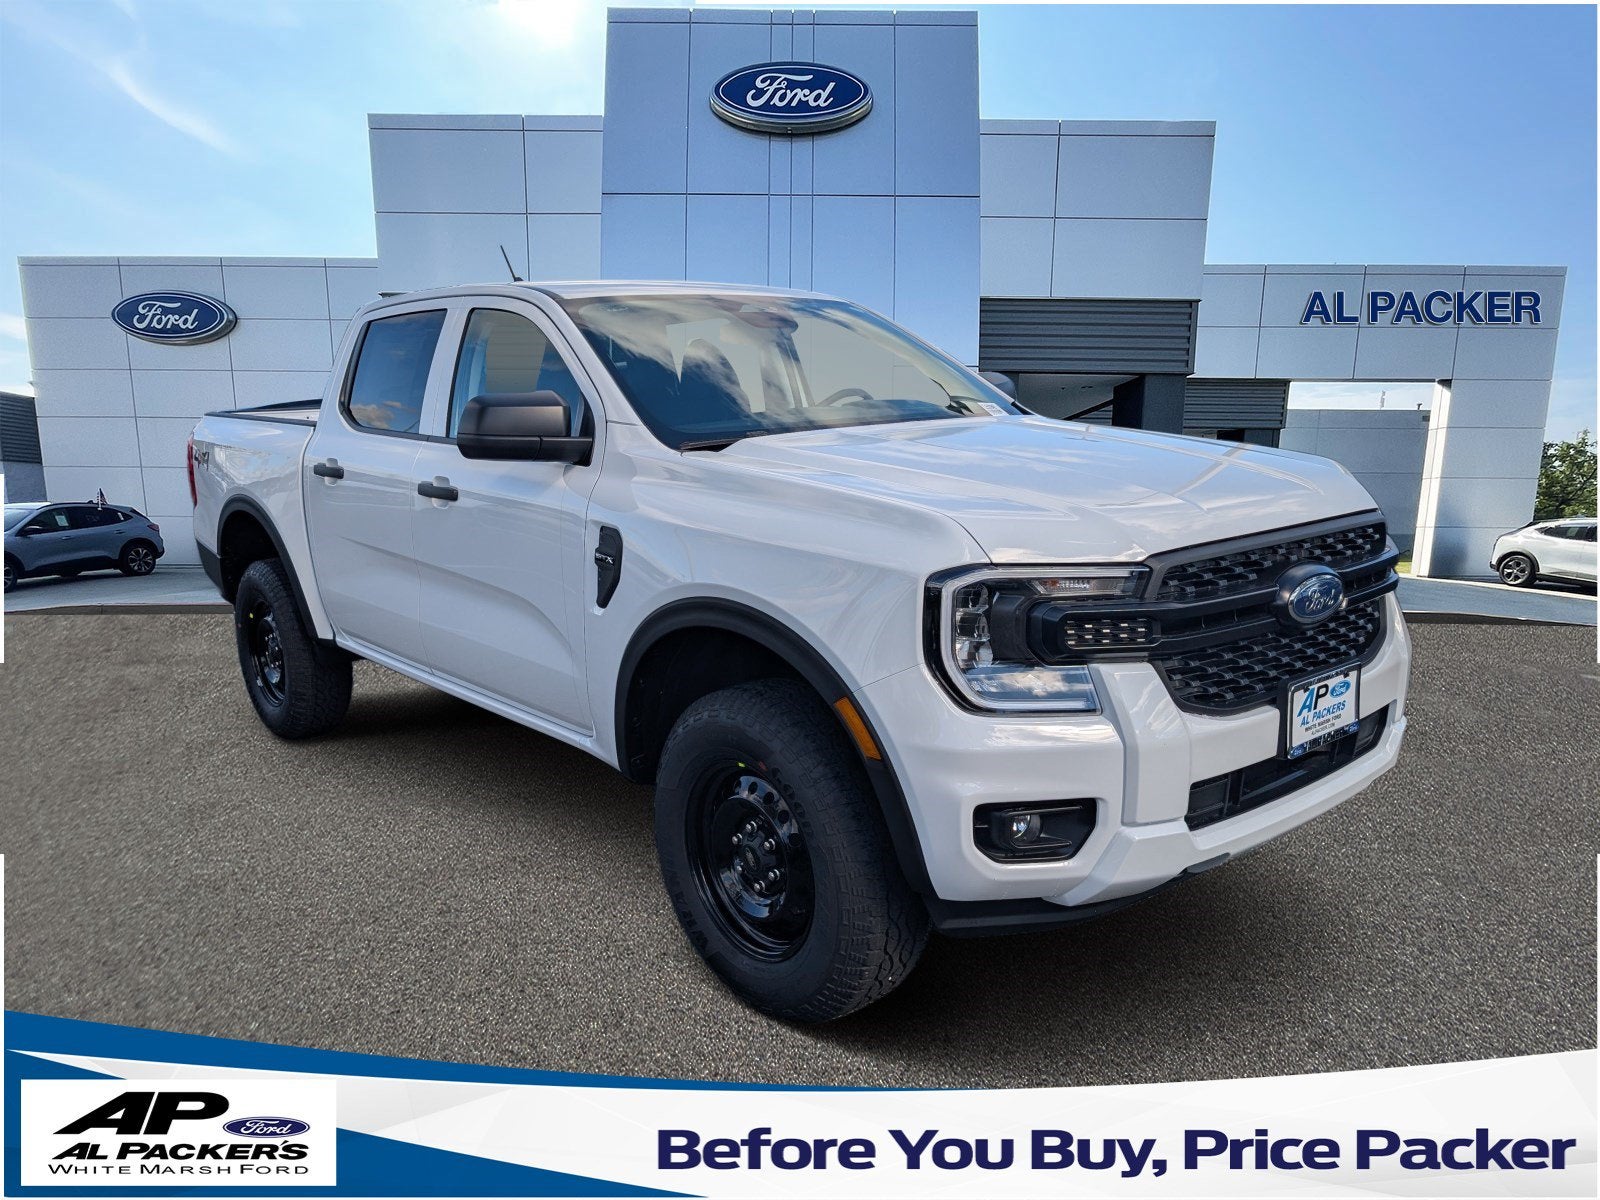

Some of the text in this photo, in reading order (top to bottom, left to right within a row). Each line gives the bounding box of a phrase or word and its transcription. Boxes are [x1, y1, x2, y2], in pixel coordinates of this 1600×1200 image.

[746, 73, 836, 107] Ford
[133, 301, 198, 329] Ford
[1302, 290, 1542, 324] AL PACKER
[1305, 585, 1335, 613] Ford
[1297, 683, 1329, 717] AP
[1300, 714, 1311, 727] AL
